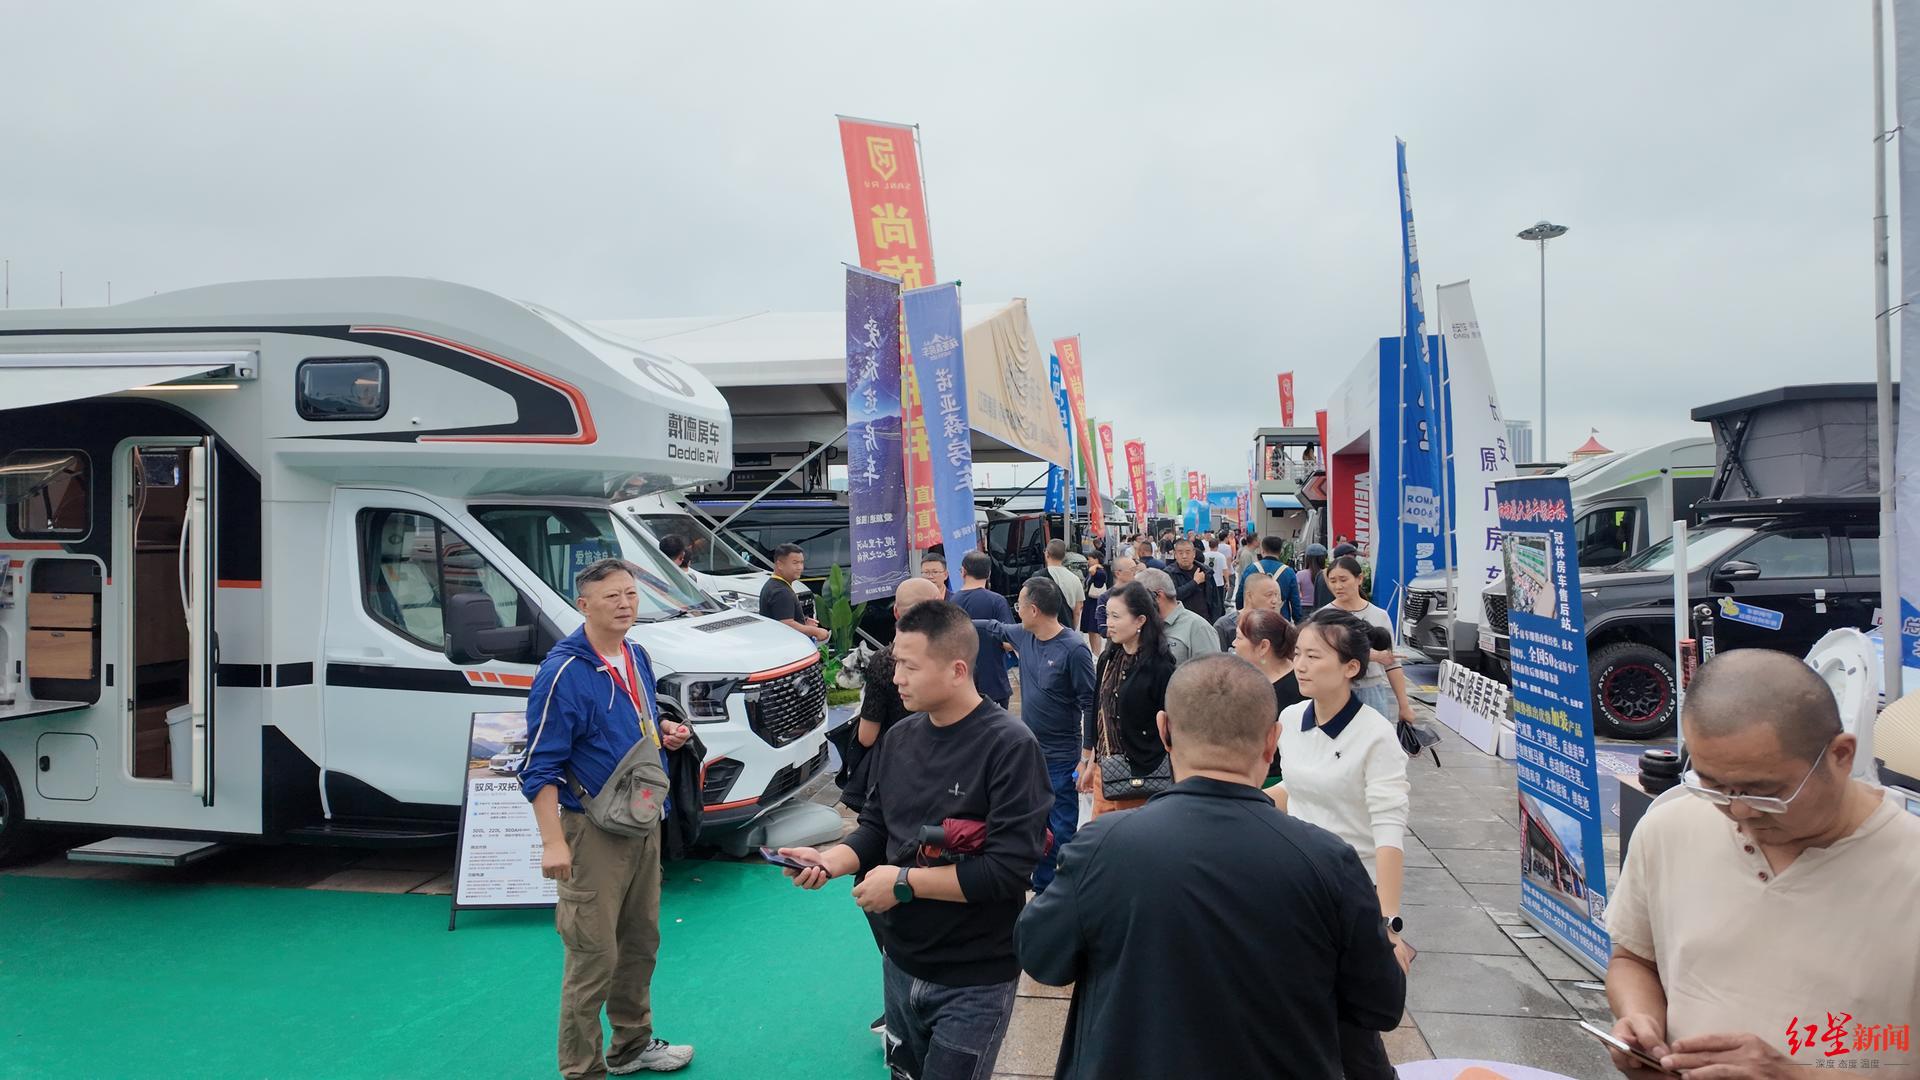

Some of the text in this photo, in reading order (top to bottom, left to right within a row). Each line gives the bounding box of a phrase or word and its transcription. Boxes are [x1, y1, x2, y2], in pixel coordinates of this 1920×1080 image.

[667, 443, 719, 464] Deddle RV
[474, 782, 522, 792] 驭风-双拓
